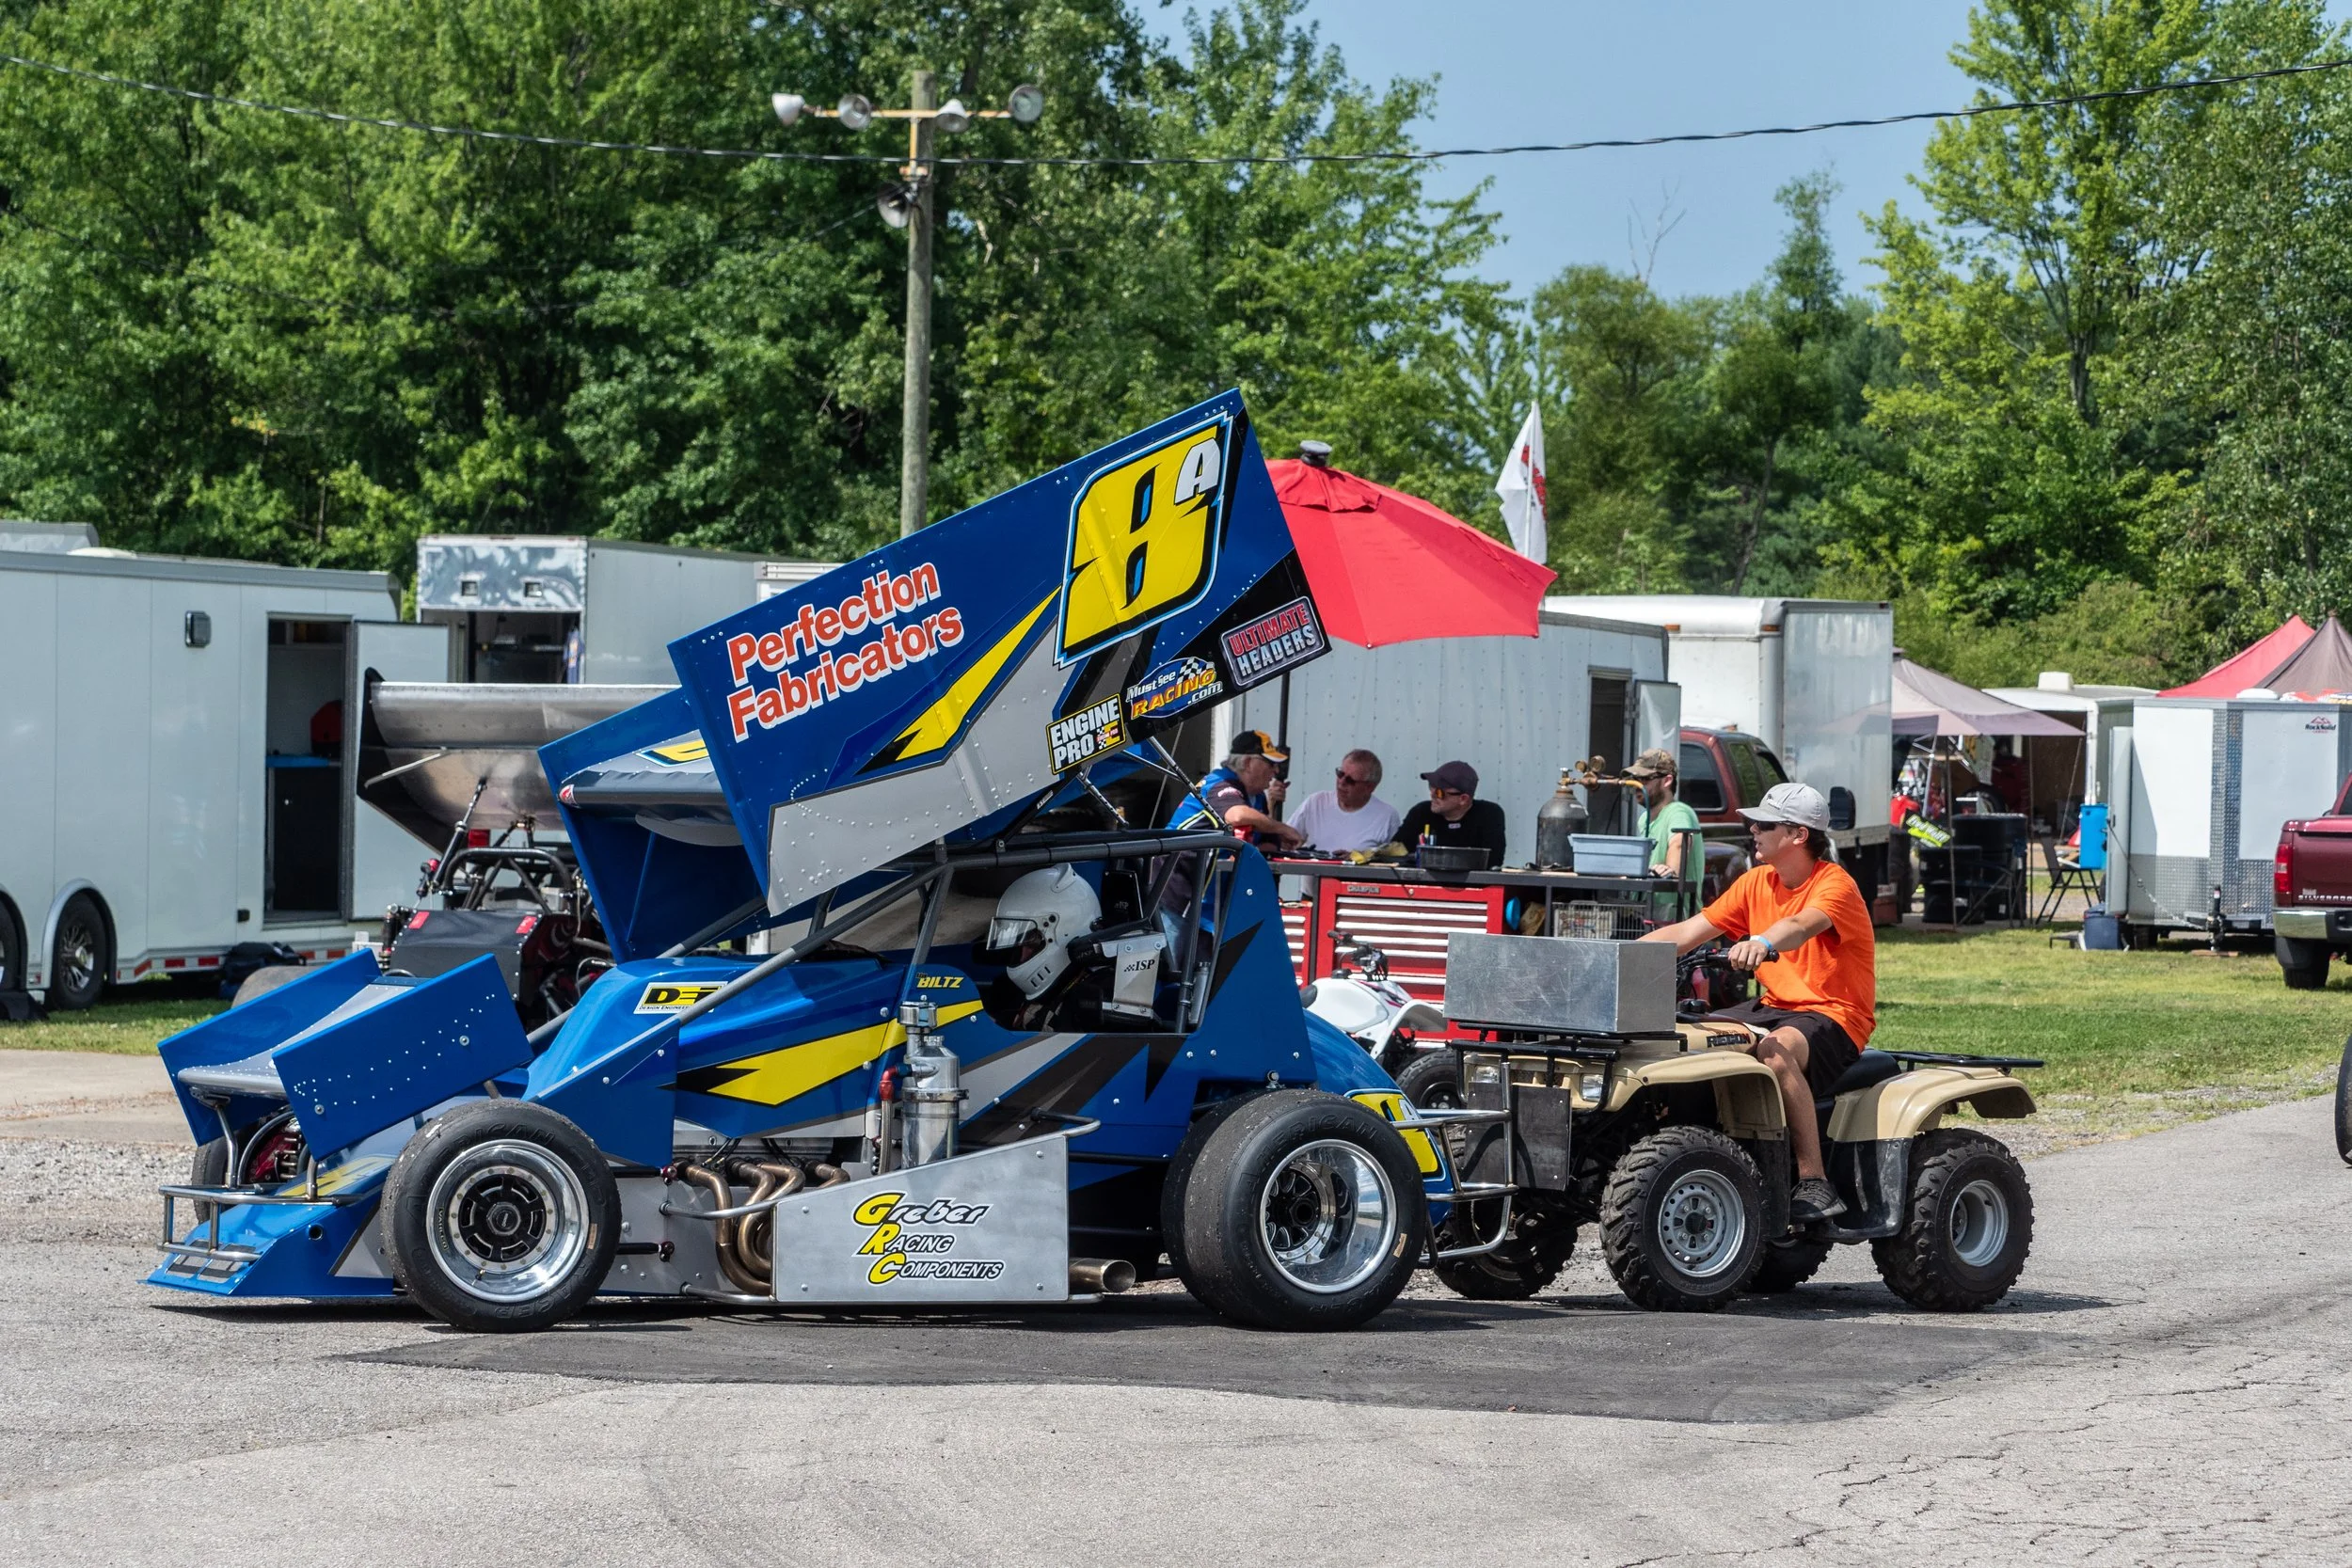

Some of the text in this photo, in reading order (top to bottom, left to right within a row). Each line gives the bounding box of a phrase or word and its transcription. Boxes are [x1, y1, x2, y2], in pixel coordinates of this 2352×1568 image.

[727, 562, 942, 687] Perfection
[1229, 603, 1311, 657] ULTIMATE
[1237, 625, 1317, 676] HEADERS
[727, 607, 965, 743] Fabricators
[1131, 667, 1216, 721] RACING
[1187, 680, 1223, 706] .com
[1050, 697, 1120, 749] ENGINE
[1053, 733, 1095, 770] PRO
[916, 976, 964, 989] BILTZ
[1135, 958, 1156, 973] ISP
[853, 1192, 992, 1227] Greber
[867, 1251, 1006, 1286] COMPONENTS
